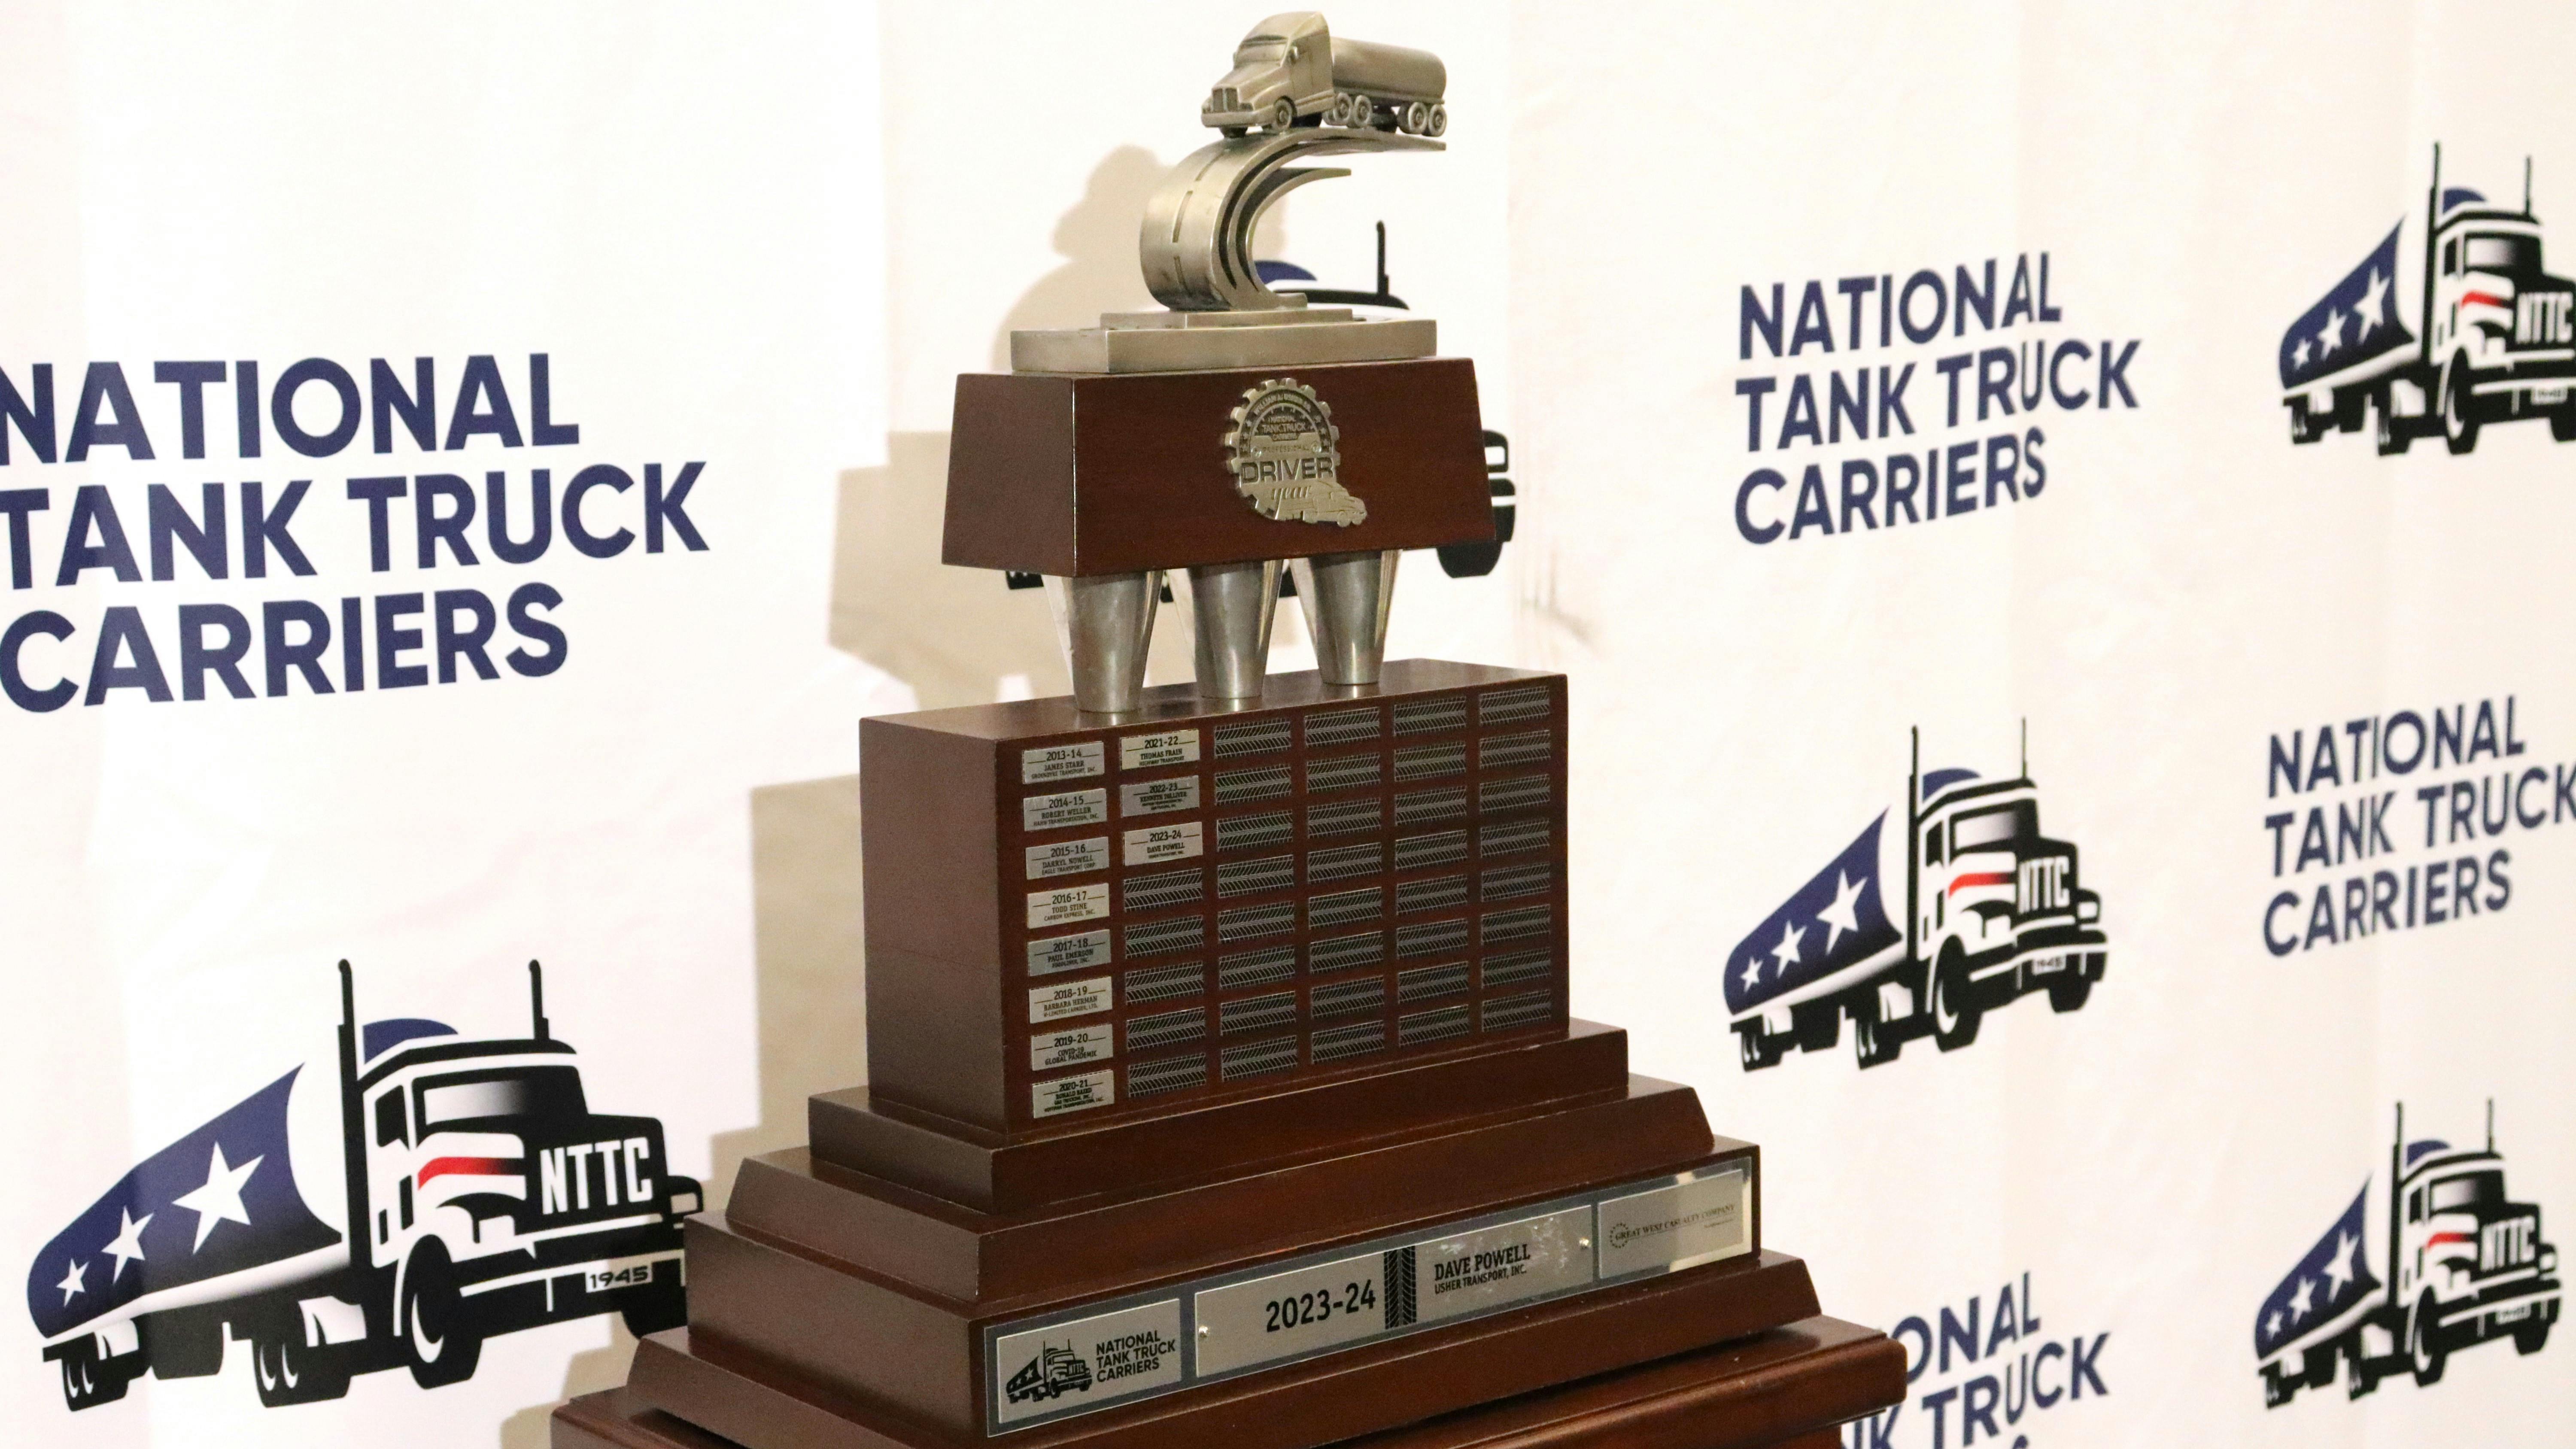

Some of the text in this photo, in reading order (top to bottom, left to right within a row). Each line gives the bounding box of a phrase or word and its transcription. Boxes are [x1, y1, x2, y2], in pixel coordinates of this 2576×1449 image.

[1740, 252, 2062, 360] NATIONAL
[2515, 292, 2573, 343] NTTC
[1735, 339, 2142, 452] TANK TRUCK
[0, 353, 580, 465] NATIONAL
[1241, 456, 1337, 484] DRIVER
[1735, 426, 2046, 545] CARRIERS
[0, 461, 710, 590] TANK TRUCK
[0, 582, 568, 714] CARRIERS
[1145, 735, 1178, 748] 2021-22
[2268, 694, 2526, 799] NATIONAL
[1046, 748, 1082, 761] 2013-14
[1140, 751, 1164, 760] THOMAS
[1045, 762, 1063, 772] JAMES
[1149, 783, 1178, 793] 2022-23
[1042, 807, 1091, 820] ROBERT WELLER
[1048, 796, 1084, 808] 2014-15
[2265, 762, 2576, 878] TANK TRUCK
[1149, 830, 1182, 842] 2023-24
[1163, 842, 1185, 851] POWELL
[1051, 844, 1085, 857] 2015-16
[1042, 860, 1066, 869] DARRYL
[1057, 864, 1082, 873] TRANSPORT
[2018, 856, 2070, 914] NTTC
[1052, 891, 1087, 904] 2016-17
[1069, 903, 1087, 911] STINE
[2263, 849, 2512, 957] CARRIERS
[1053, 938, 1088, 952] 2017-18
[1066, 948, 1094, 959] EMERSON
[1044, 995, 1097, 1011] BARBARA HERMAN
[1054, 986, 1088, 1000] 2018-19
[1054, 1033, 1088, 1047] 2019-20
[1045, 1050, 1097, 1065] GLOBAL PANDEMIC
[1058, 1047, 1084, 1057] COVID-19
[1059, 1079, 1088, 1092] 2020-21
[540, 1137, 653, 1215] NTTC
[1615, 1227, 1640, 1240] GREAT
[1642, 1222, 1662, 1233] WEST
[1664, 1213, 1699, 1228] CASALTY
[2480, 1215, 2535, 1272] NTTC
[1434, 1244, 1531, 1281] DAVE POWELL
[589, 1266, 648, 1288] 1945
[1434, 1279, 1461, 1295] USHER
[1463, 1268, 1509, 1287] TRANSPORT,
[1266, 1279, 1376, 1333] 2023-24
[1890, 1270, 2041, 1386] ONAL
[1096, 1330, 1160, 1355] NATIONAL
[1096, 1340, 1176, 1369] TANK TRUCK
[1097, 1357, 1160, 1382] CARRIERS
[1921, 1331, 2111, 1449] TRUCK
